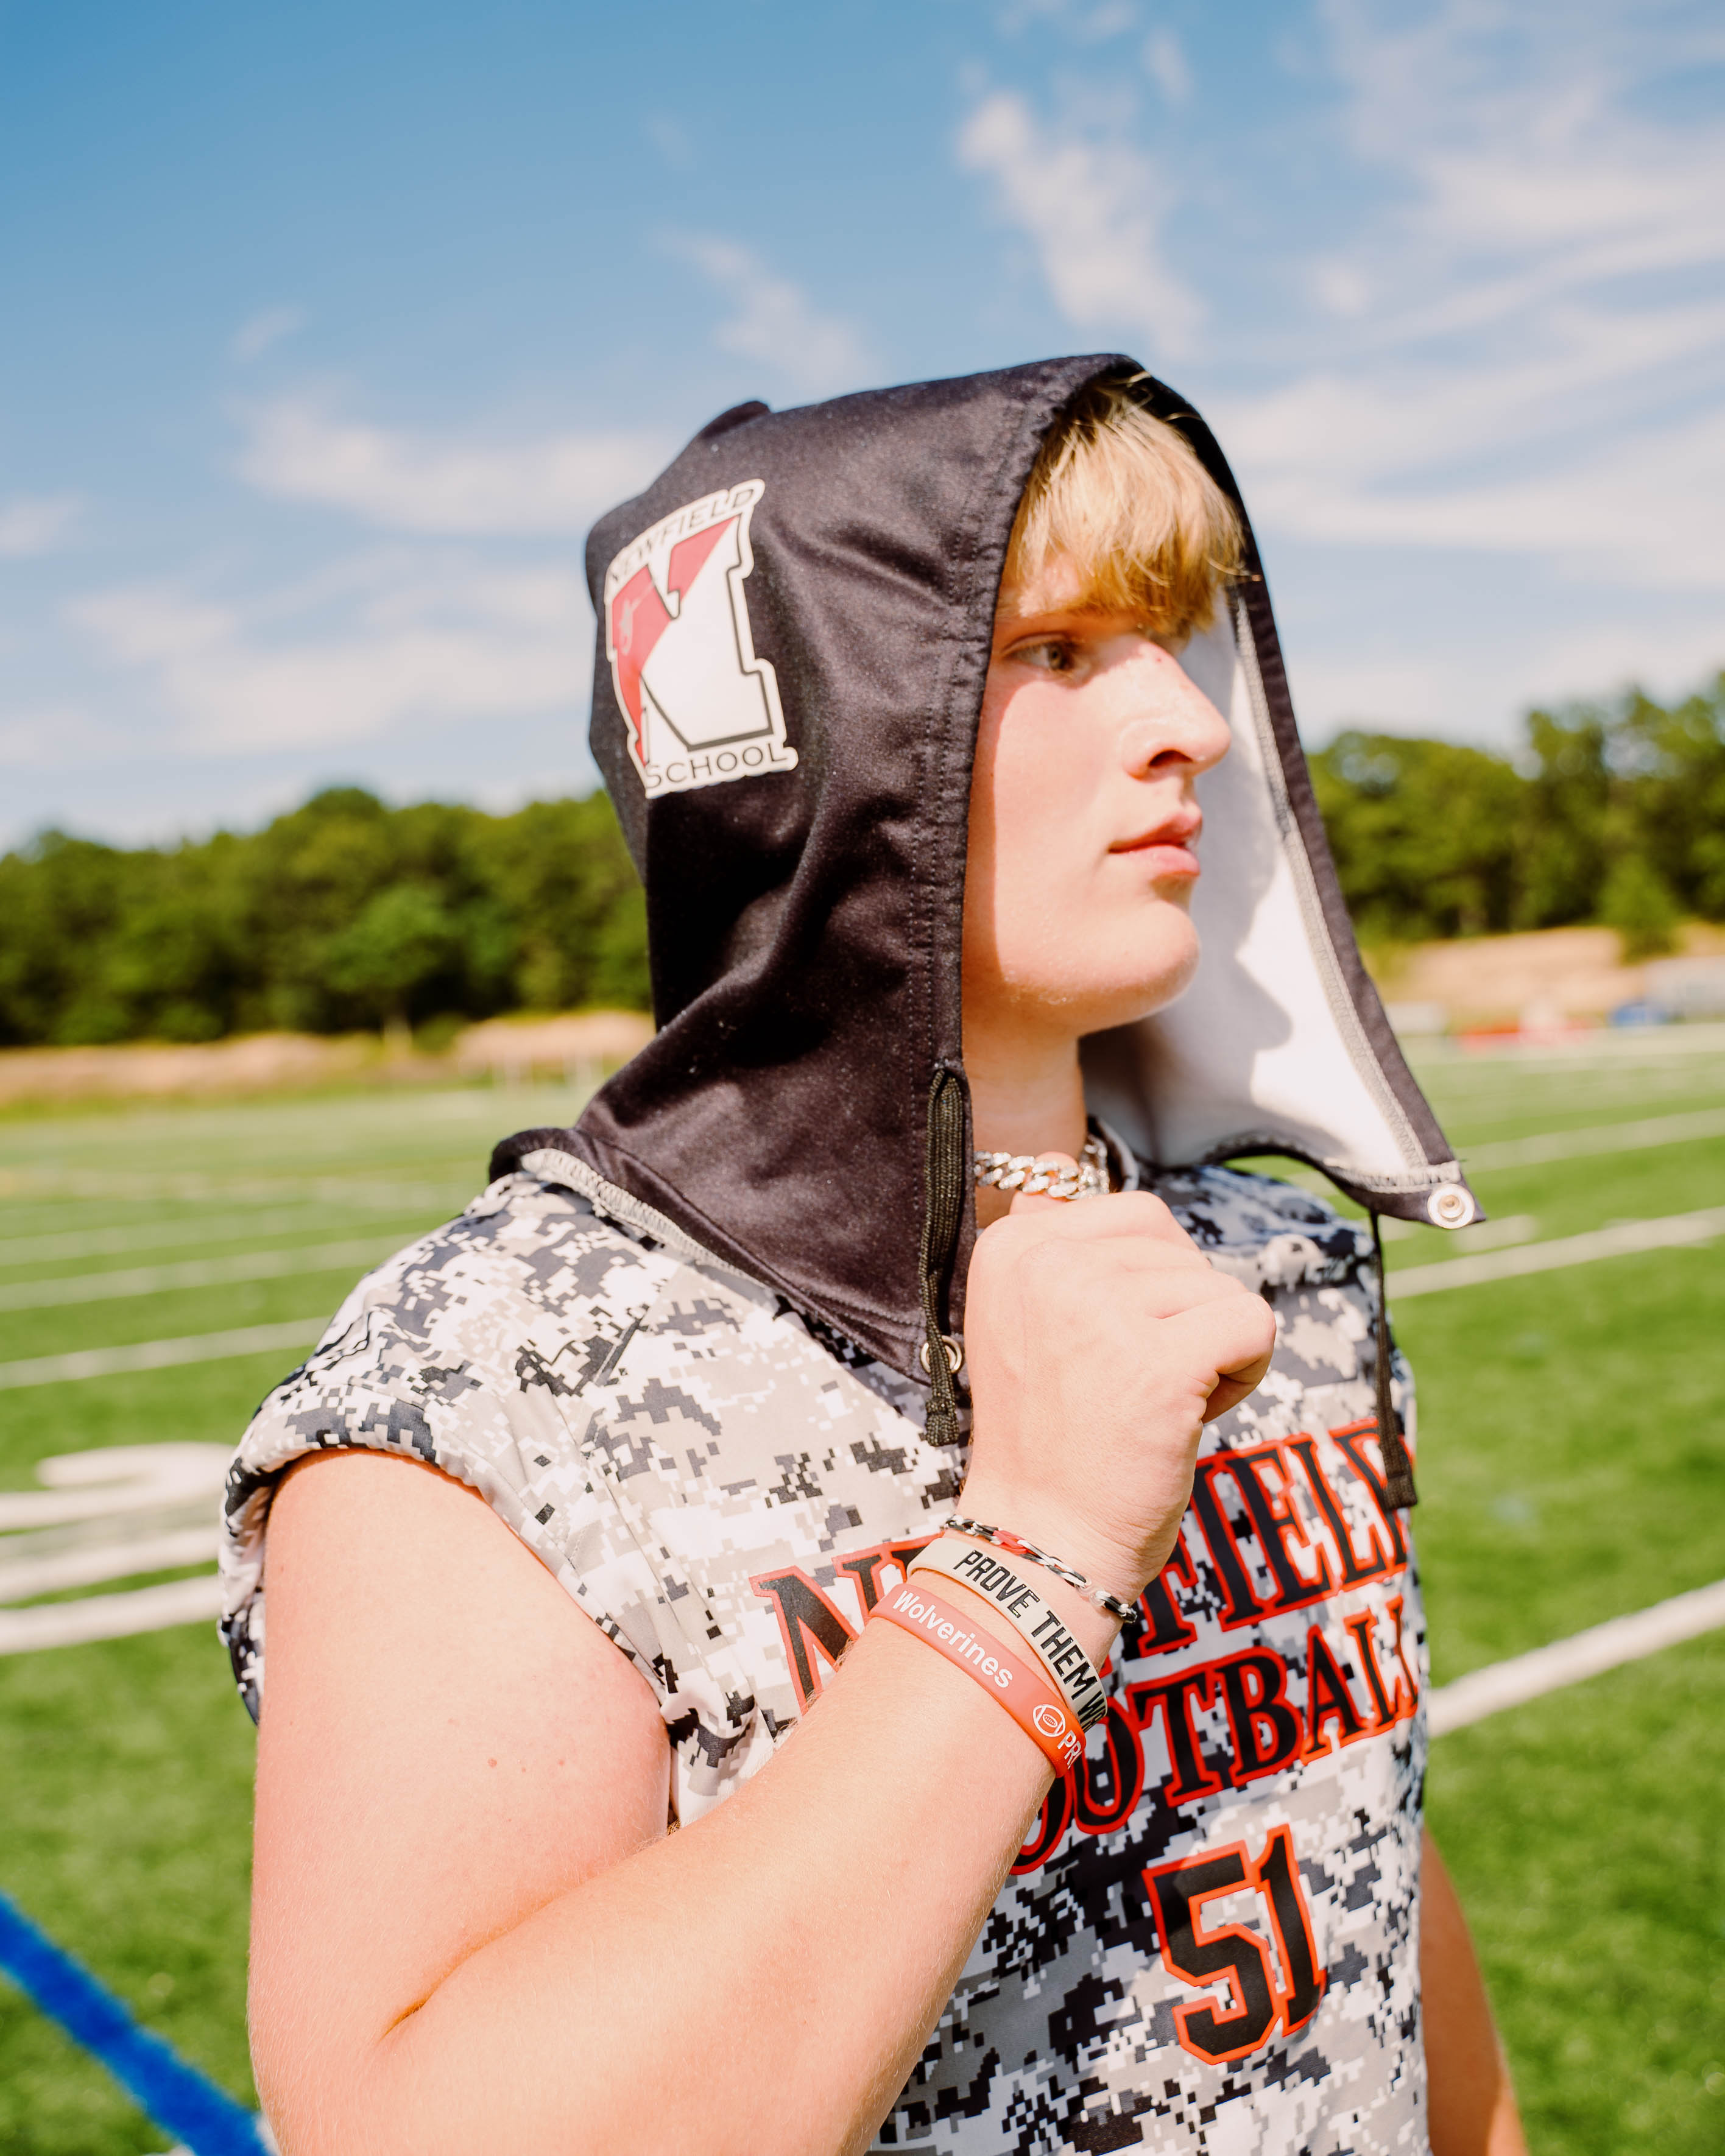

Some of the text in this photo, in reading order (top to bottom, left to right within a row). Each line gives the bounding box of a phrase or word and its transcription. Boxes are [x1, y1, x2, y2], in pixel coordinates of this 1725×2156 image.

[645, 742, 788, 789] SCHOOL
[892, 1590, 1014, 1688] Wolverines
[953, 1549, 1040, 1618] PROVE
[1031, 1610, 1098, 1700] THEM
[1141, 1823, 1327, 2066] 51
